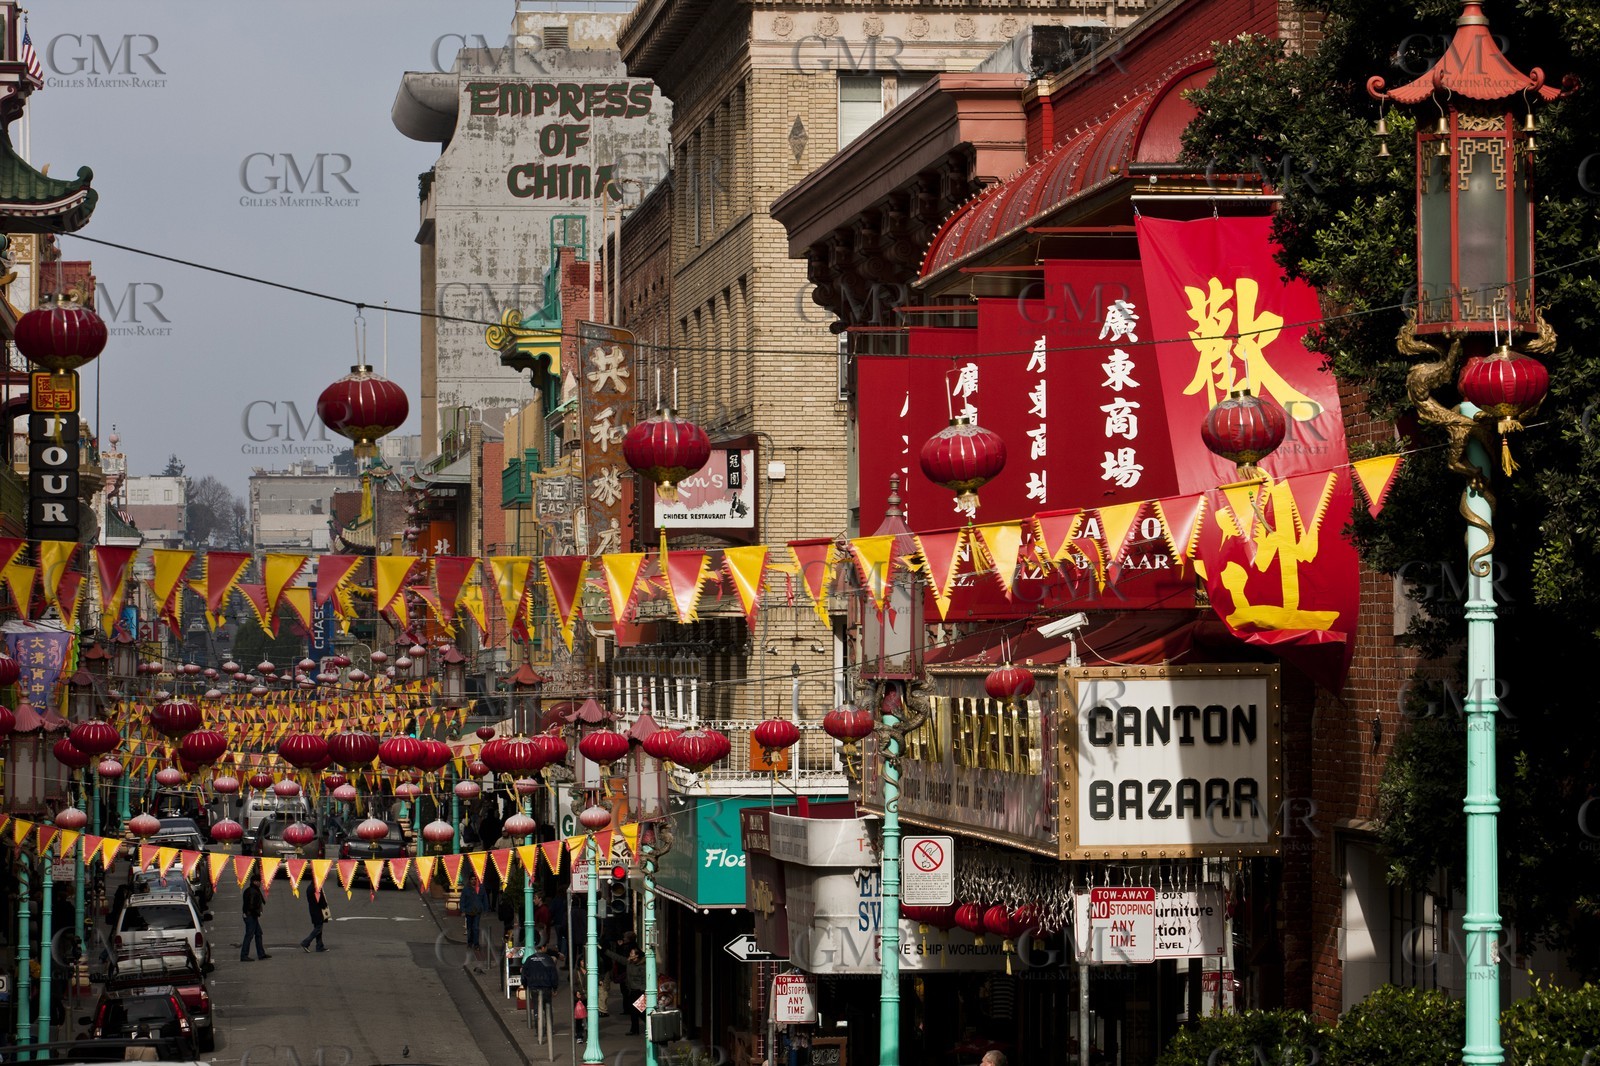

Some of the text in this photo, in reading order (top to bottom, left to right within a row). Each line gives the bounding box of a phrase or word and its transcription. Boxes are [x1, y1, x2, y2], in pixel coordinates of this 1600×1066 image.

[464, 82, 654, 121] EMPRESS
[539, 124, 589, 158] OF
[507, 163, 623, 201] CHINA
[1098, 300, 1145, 488] 廣東商場
[41, 417, 69, 523] FOUR
[1088, 705, 1257, 747] CANTON
[1089, 778, 1258, 821] BAZAAR
[1097, 890, 1149, 900] TOW-AWAY
[1091, 901, 1153, 918] NO STOPPING
[1155, 904, 1213, 918] urniture
[1111, 920, 1135, 932] ANY
[1155, 925, 1186, 937] tion
[1110, 935, 1136, 947] TIME
[915, 944, 943, 955] SHIP
[776, 984, 815, 995] NO STOPPING
[788, 997, 804, 1005] ANY
[787, 1006, 804, 1015] TIME
